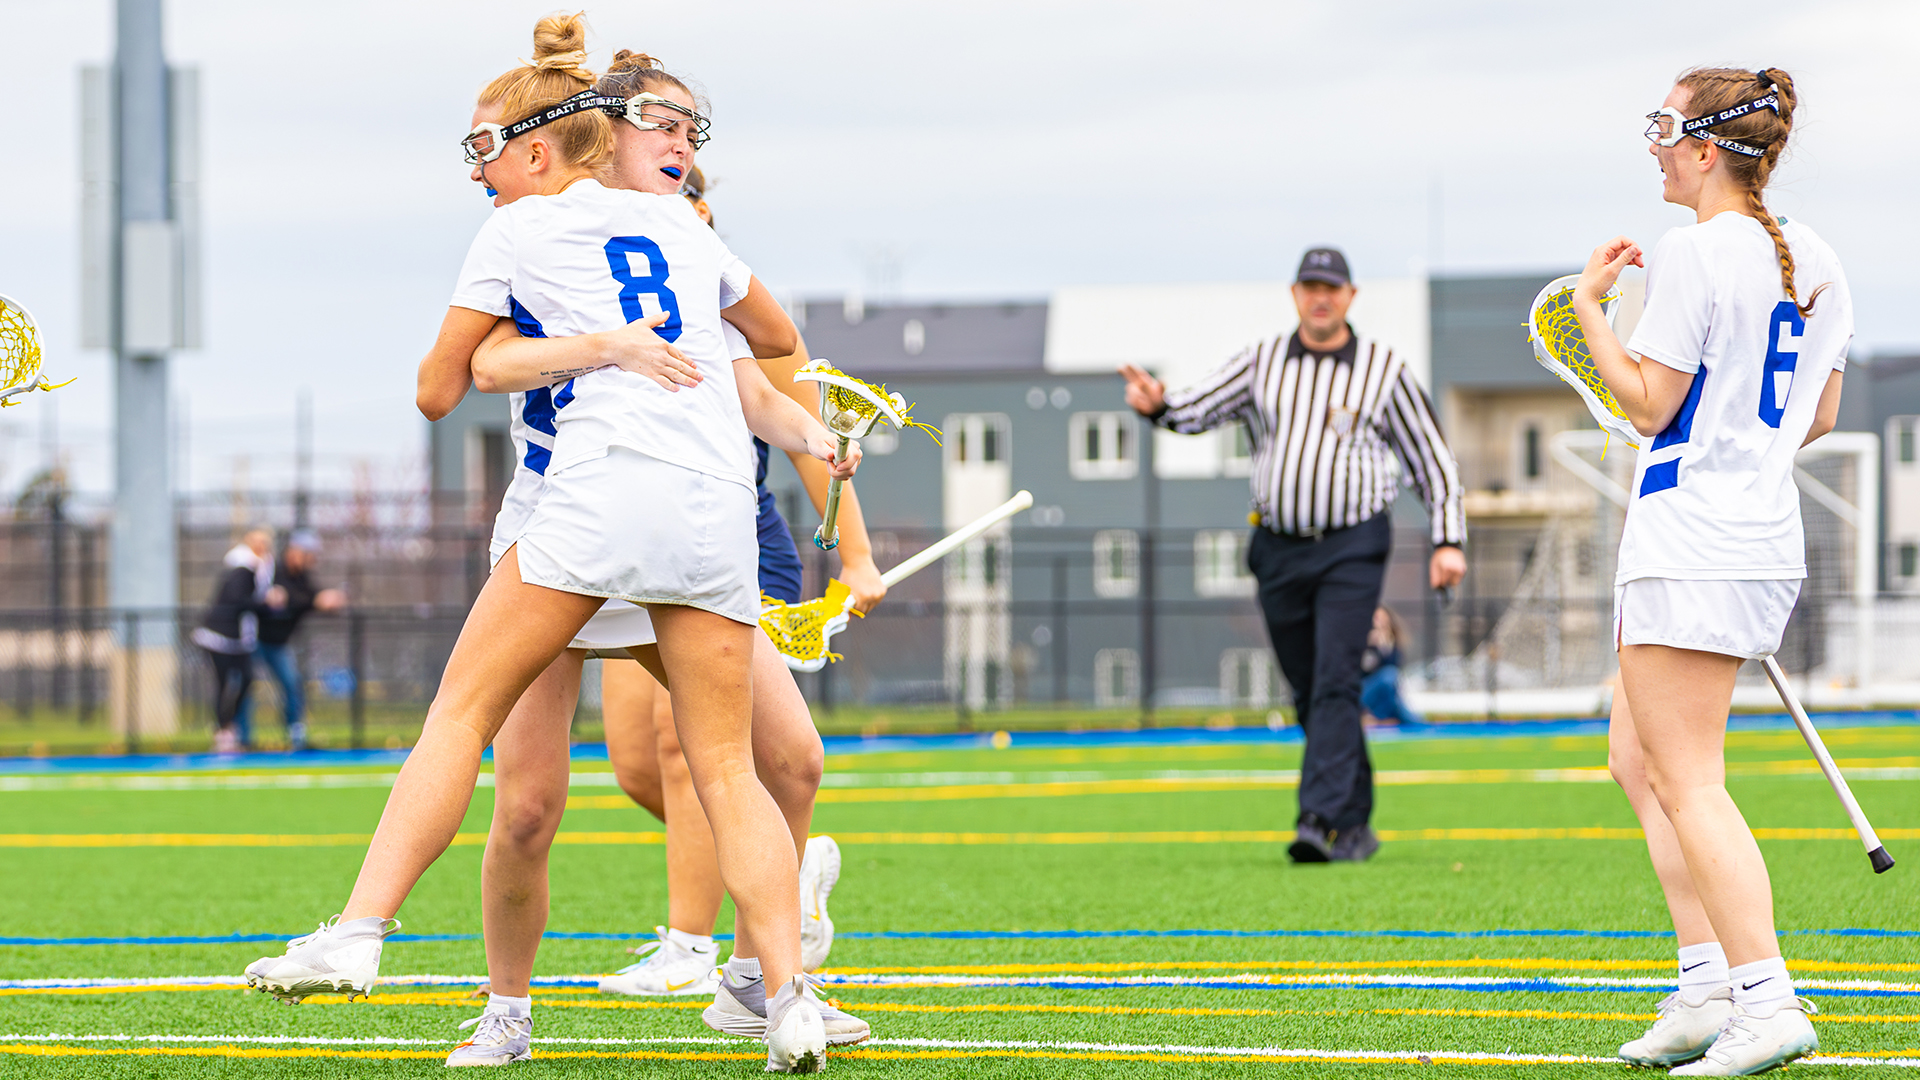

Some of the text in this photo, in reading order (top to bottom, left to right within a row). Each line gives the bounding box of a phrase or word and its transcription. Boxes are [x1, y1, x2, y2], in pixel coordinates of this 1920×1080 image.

[512, 116, 541, 134] GAIT
[546, 103, 576, 120] GAIT
[1685, 115, 1715, 130] GAIT
[1719, 104, 1750, 120] GAIT
[603, 236, 683, 344] 8
[1758, 301, 1807, 429] 6
